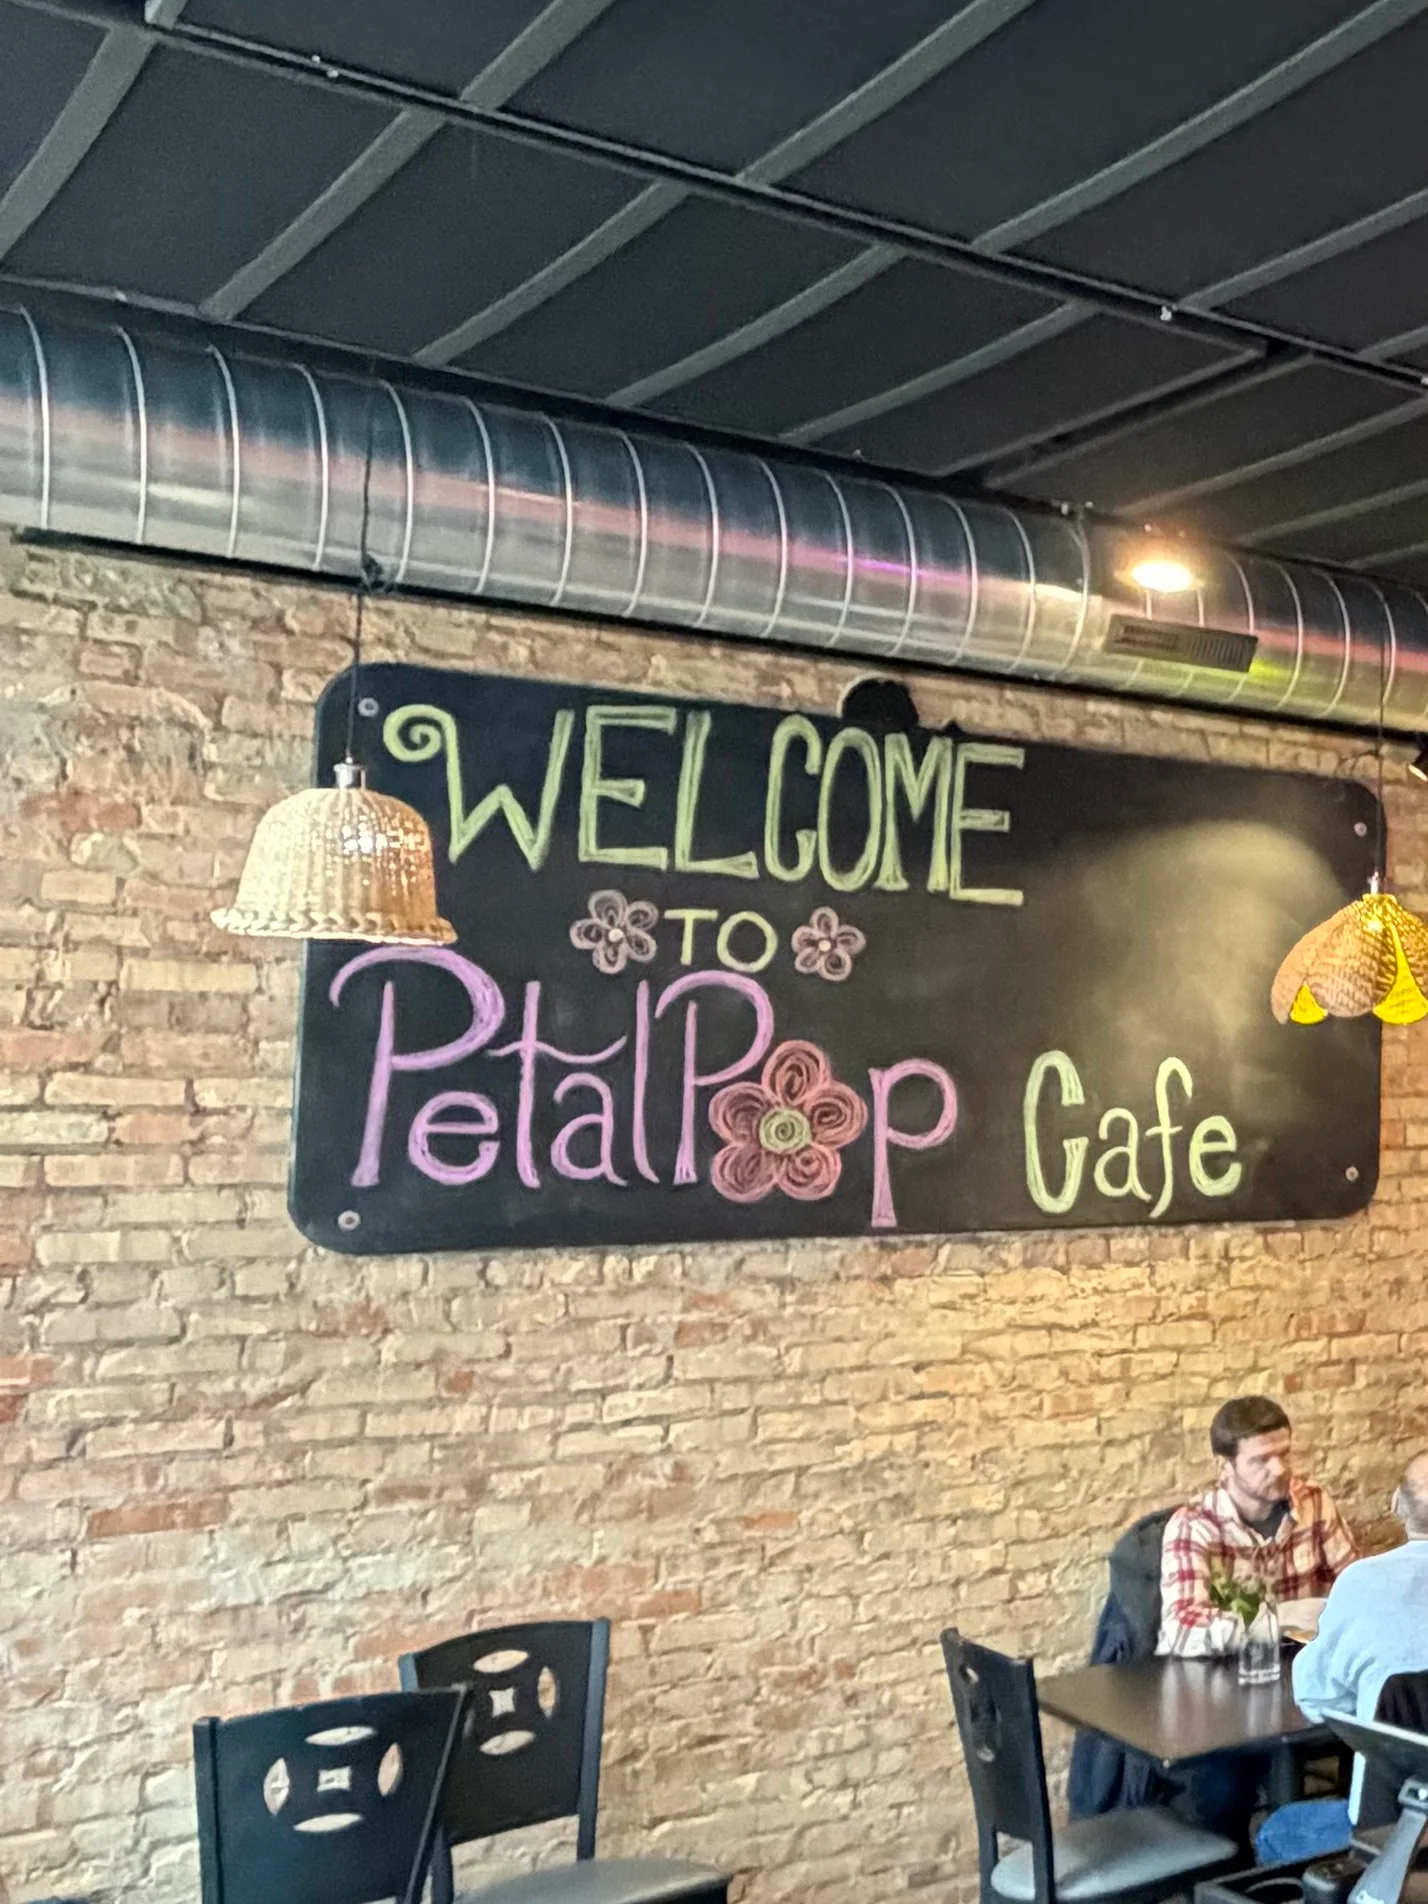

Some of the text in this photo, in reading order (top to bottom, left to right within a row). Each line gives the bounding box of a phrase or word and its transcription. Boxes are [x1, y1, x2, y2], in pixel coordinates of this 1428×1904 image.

[383, 703, 1025, 906] WELCOME
[664, 908, 777, 973] TO
[1023, 1049, 1245, 1219] Cafe
